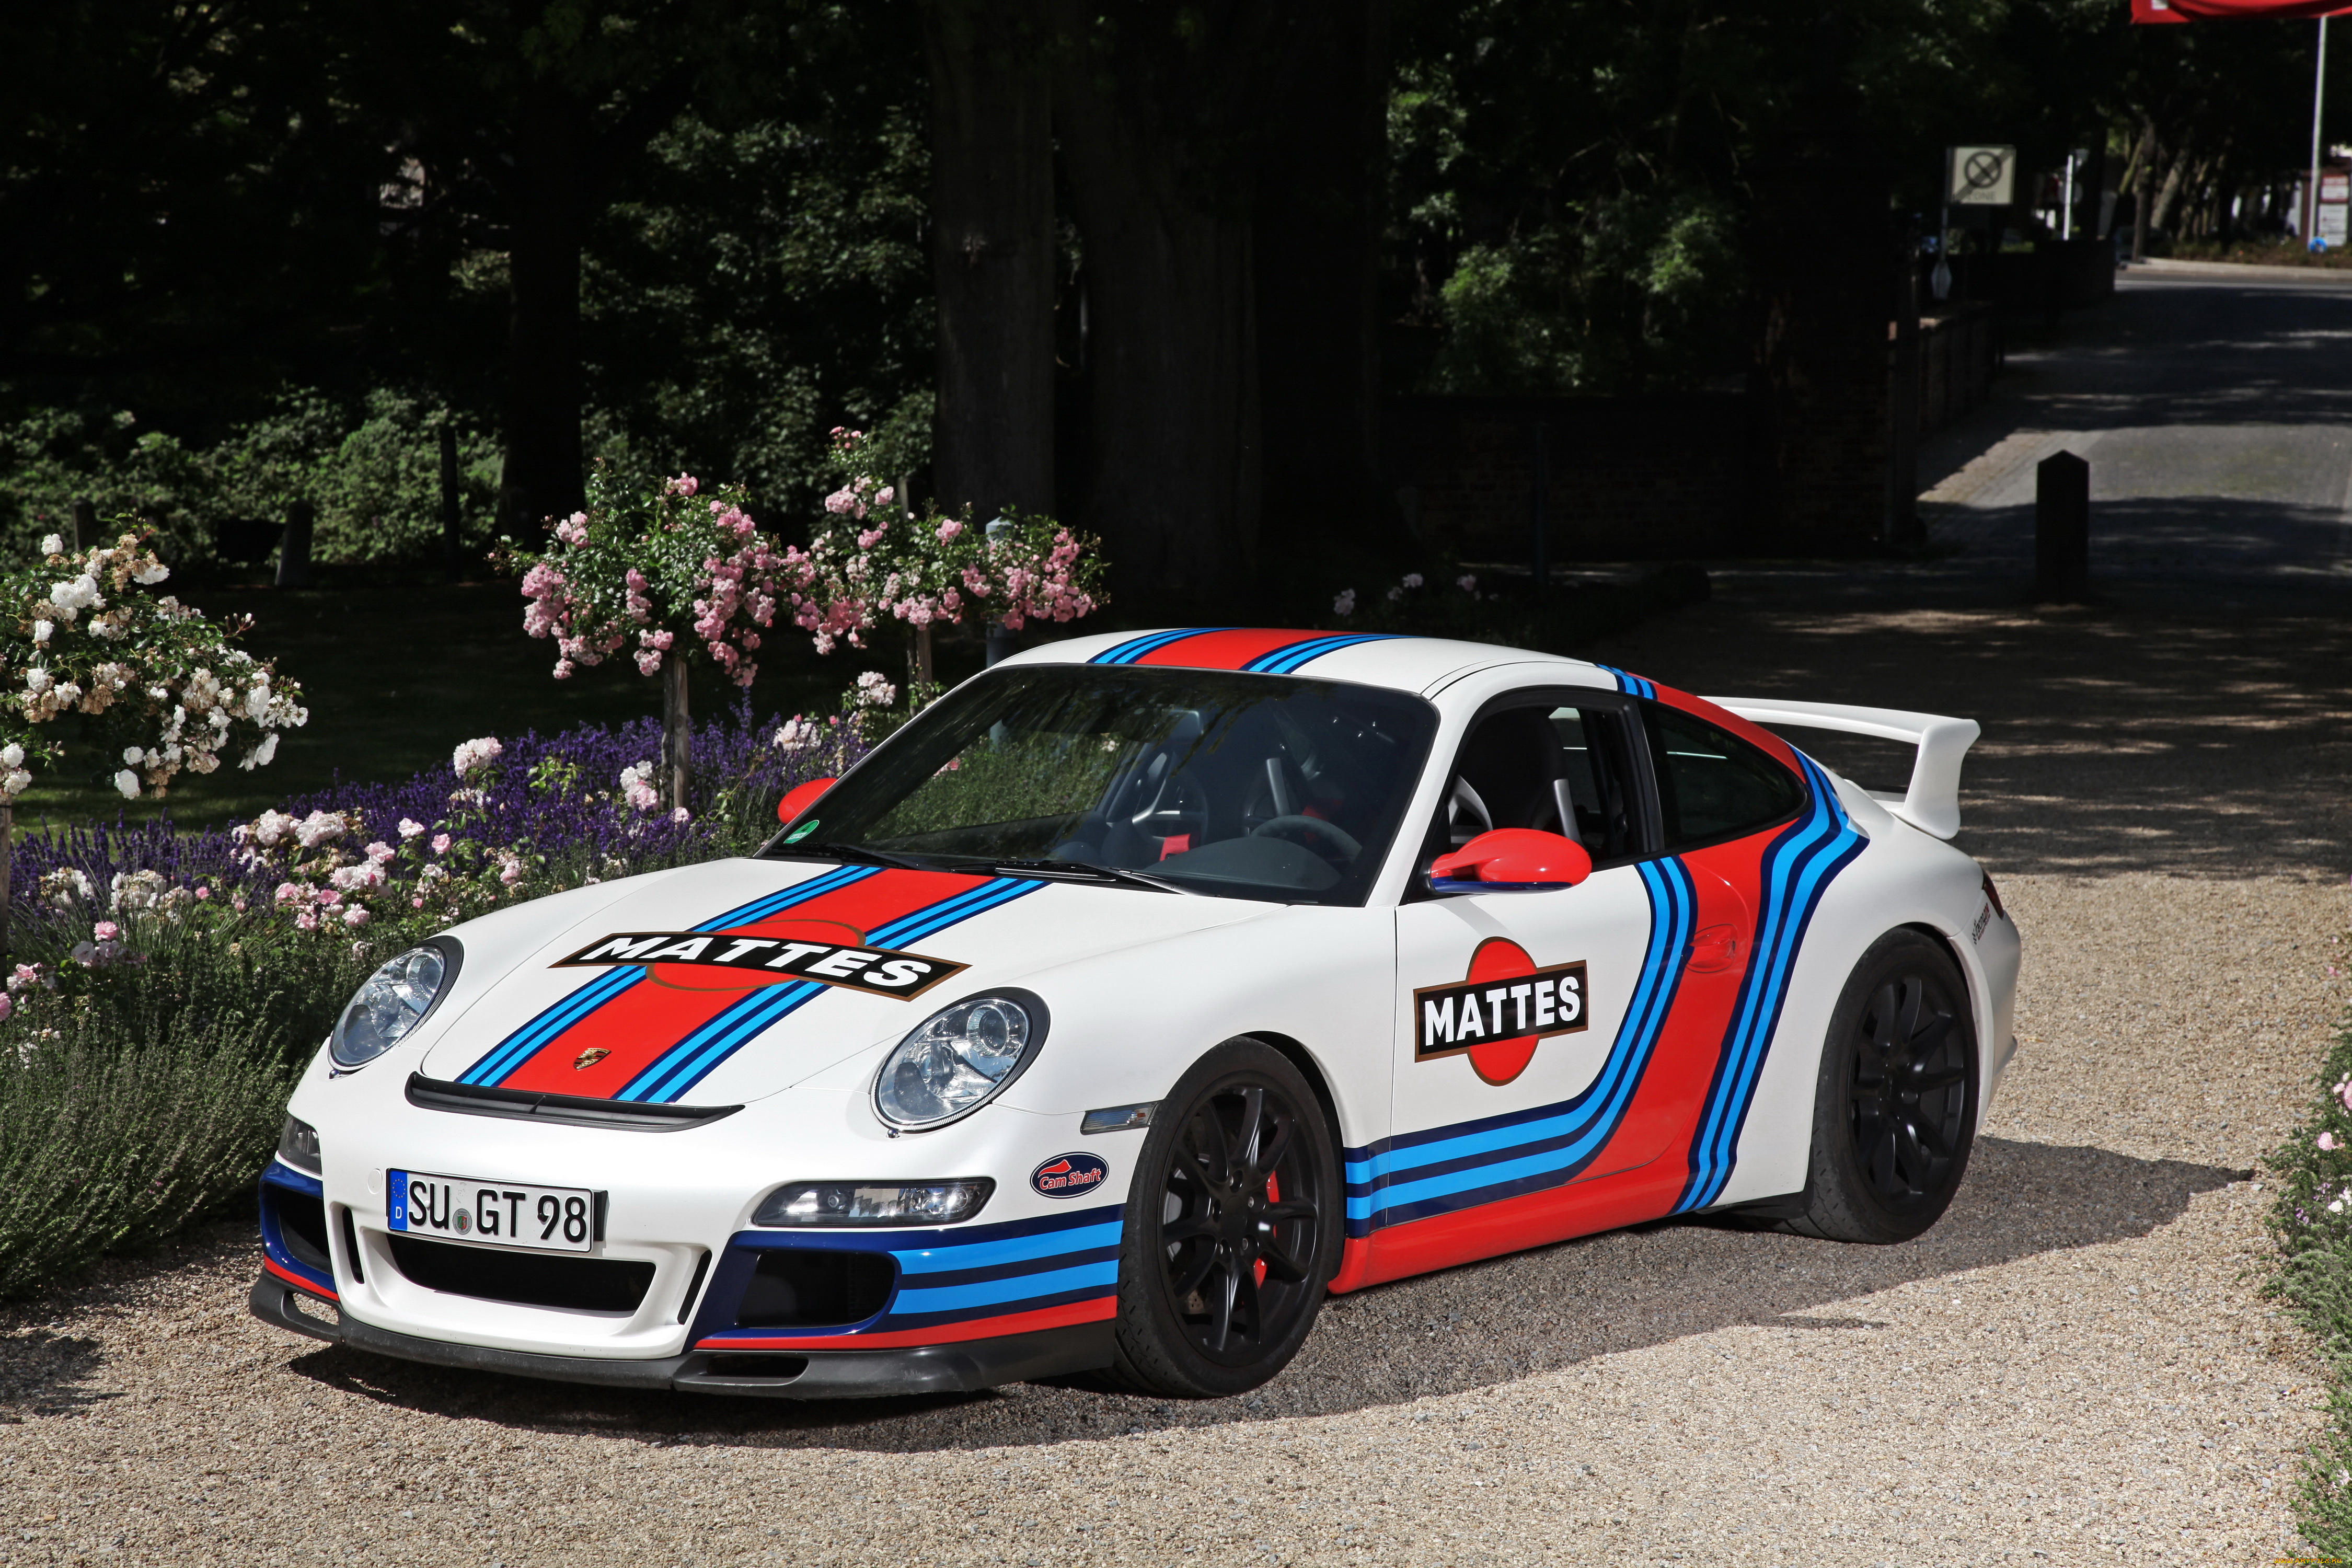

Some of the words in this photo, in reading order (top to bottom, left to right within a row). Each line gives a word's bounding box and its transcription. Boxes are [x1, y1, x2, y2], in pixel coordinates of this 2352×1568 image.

[579, 937, 932, 987] MATTES
[1424, 976, 1581, 1047] MATTES
[1039, 1176, 1067, 1190] Cam
[1068, 1168, 1102, 1186] Shaft
[395, 1206, 402, 1219] D
[408, 1180, 450, 1230] SU
[476, 1189, 526, 1238] GT
[537, 1194, 587, 1243] 98
